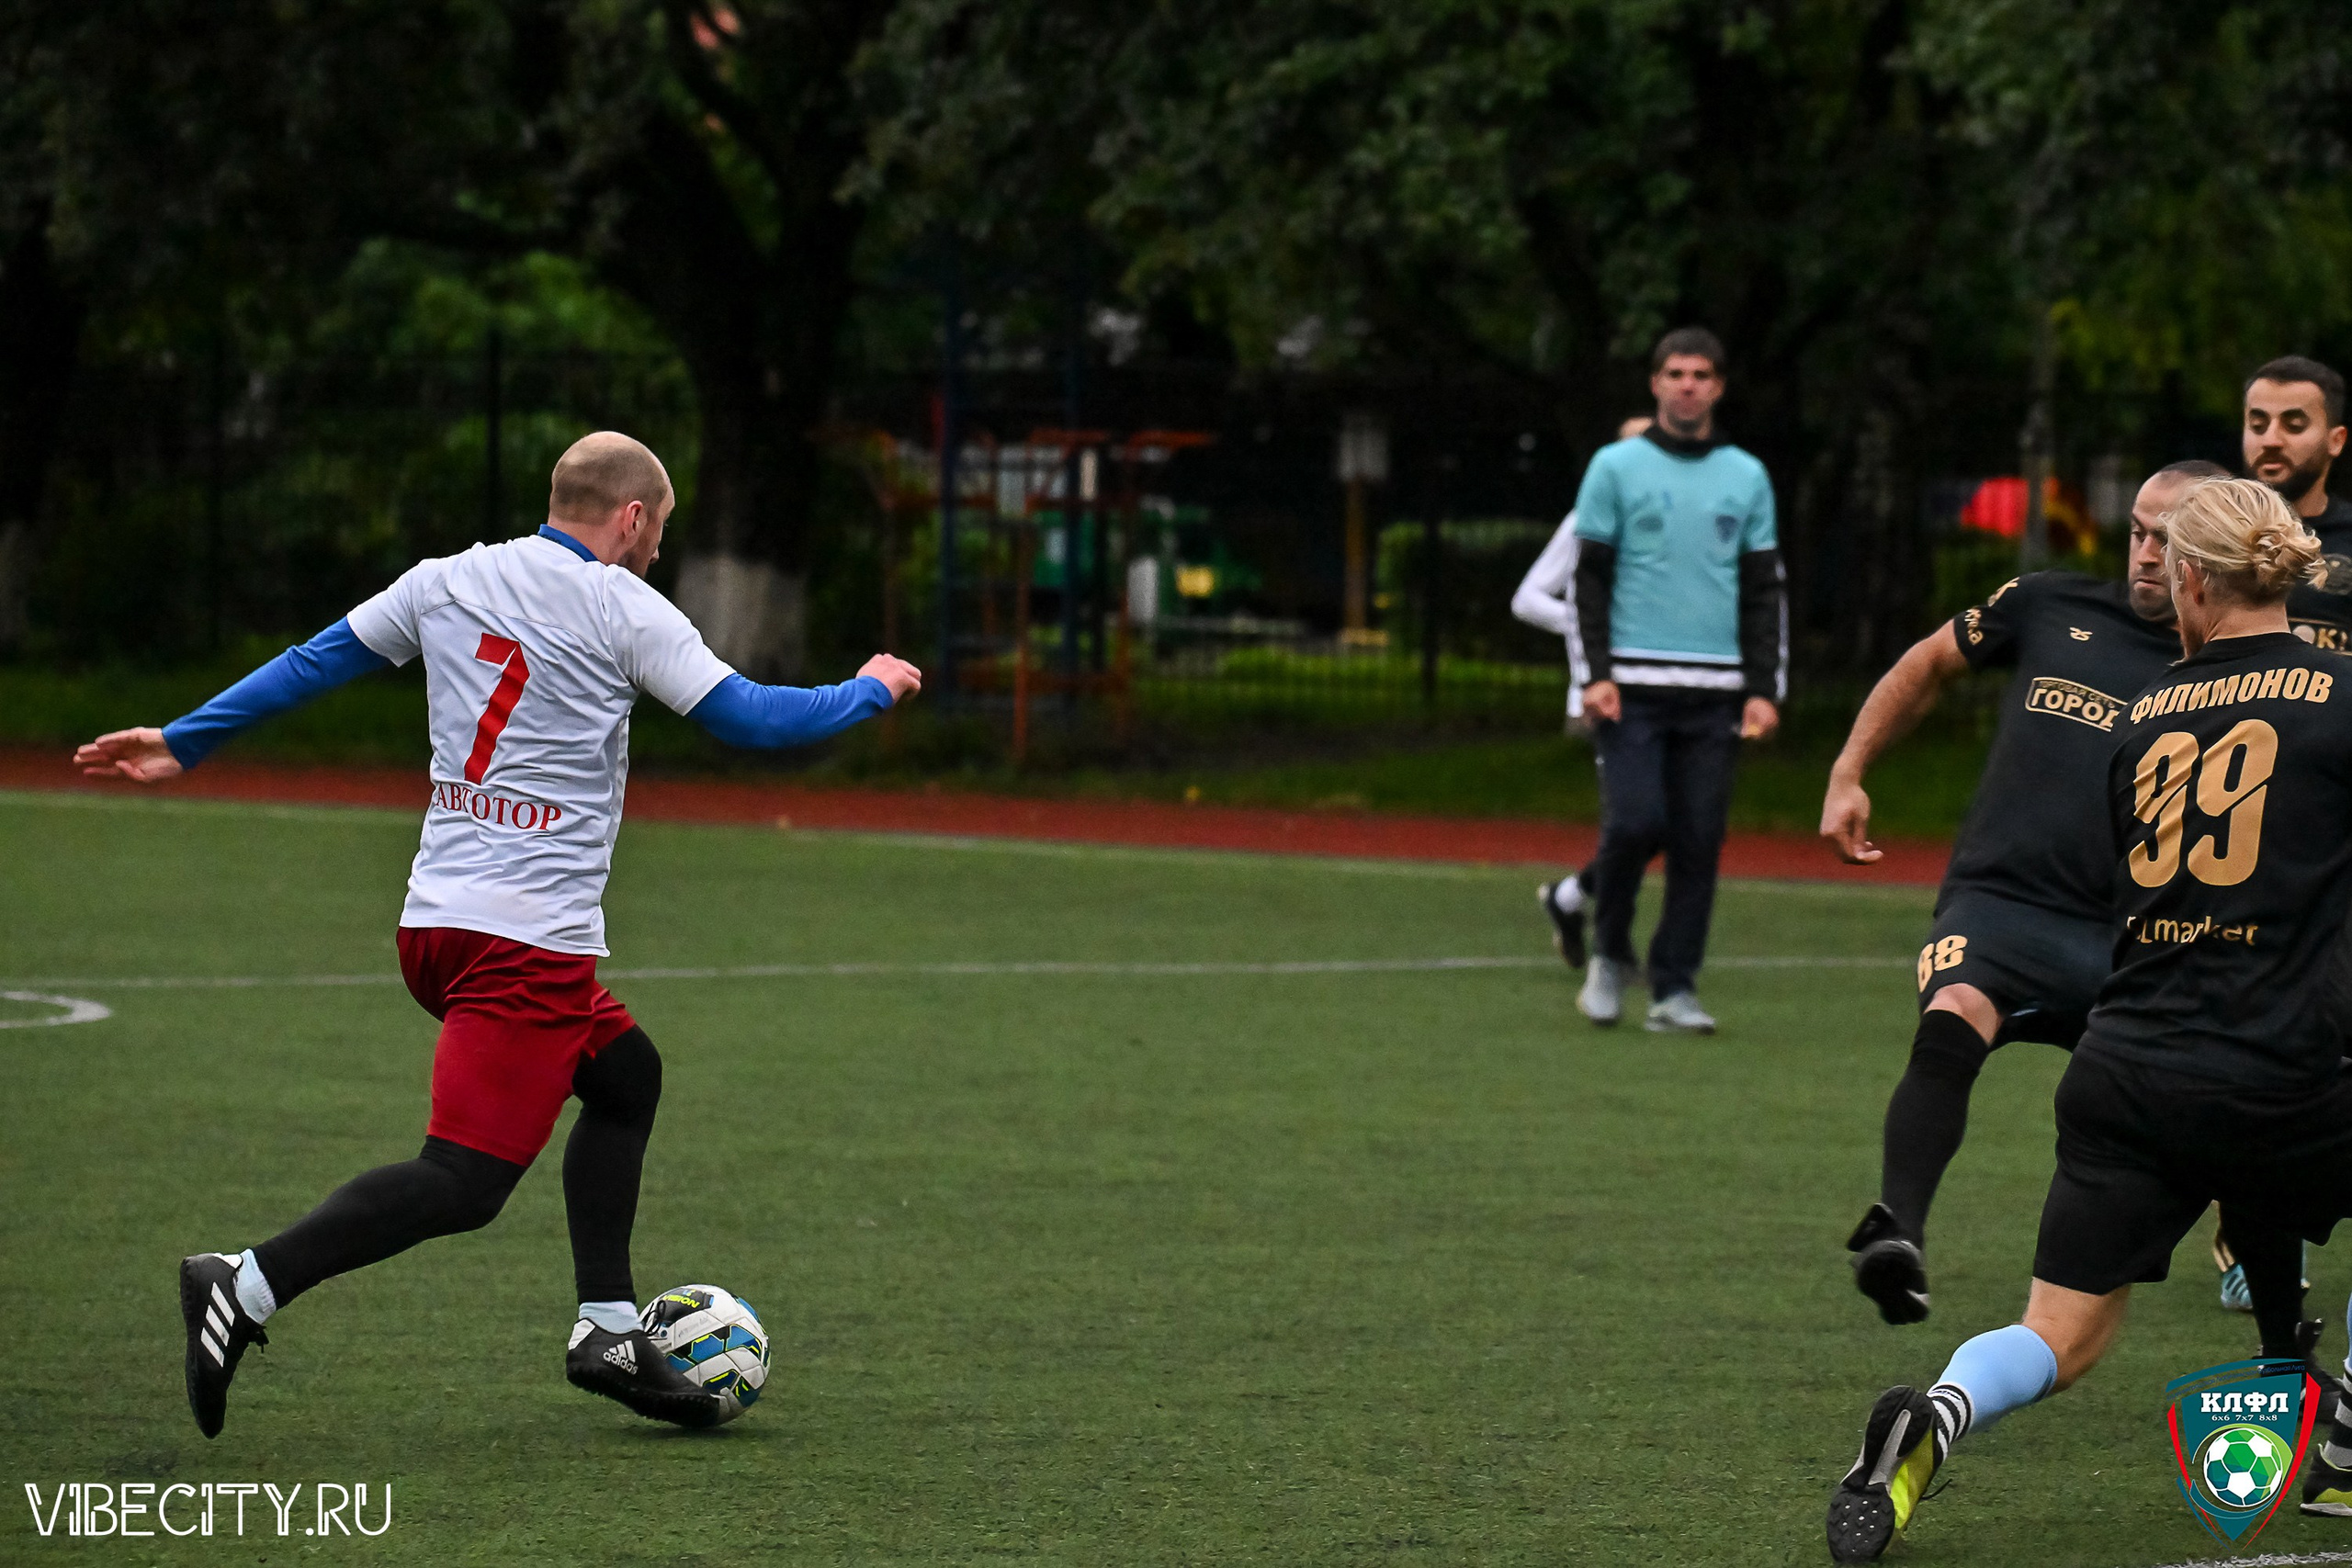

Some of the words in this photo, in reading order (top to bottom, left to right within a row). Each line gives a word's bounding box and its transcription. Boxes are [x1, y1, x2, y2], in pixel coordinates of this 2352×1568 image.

[464, 633, 530, 785] 7
[2130, 668, 2334, 725] ФИЛИМОНОВ
[435, 782, 562, 830] АВТОТОР
[2129, 718, 2278, 887] 99
[603, 1351, 639, 1375] adidas
